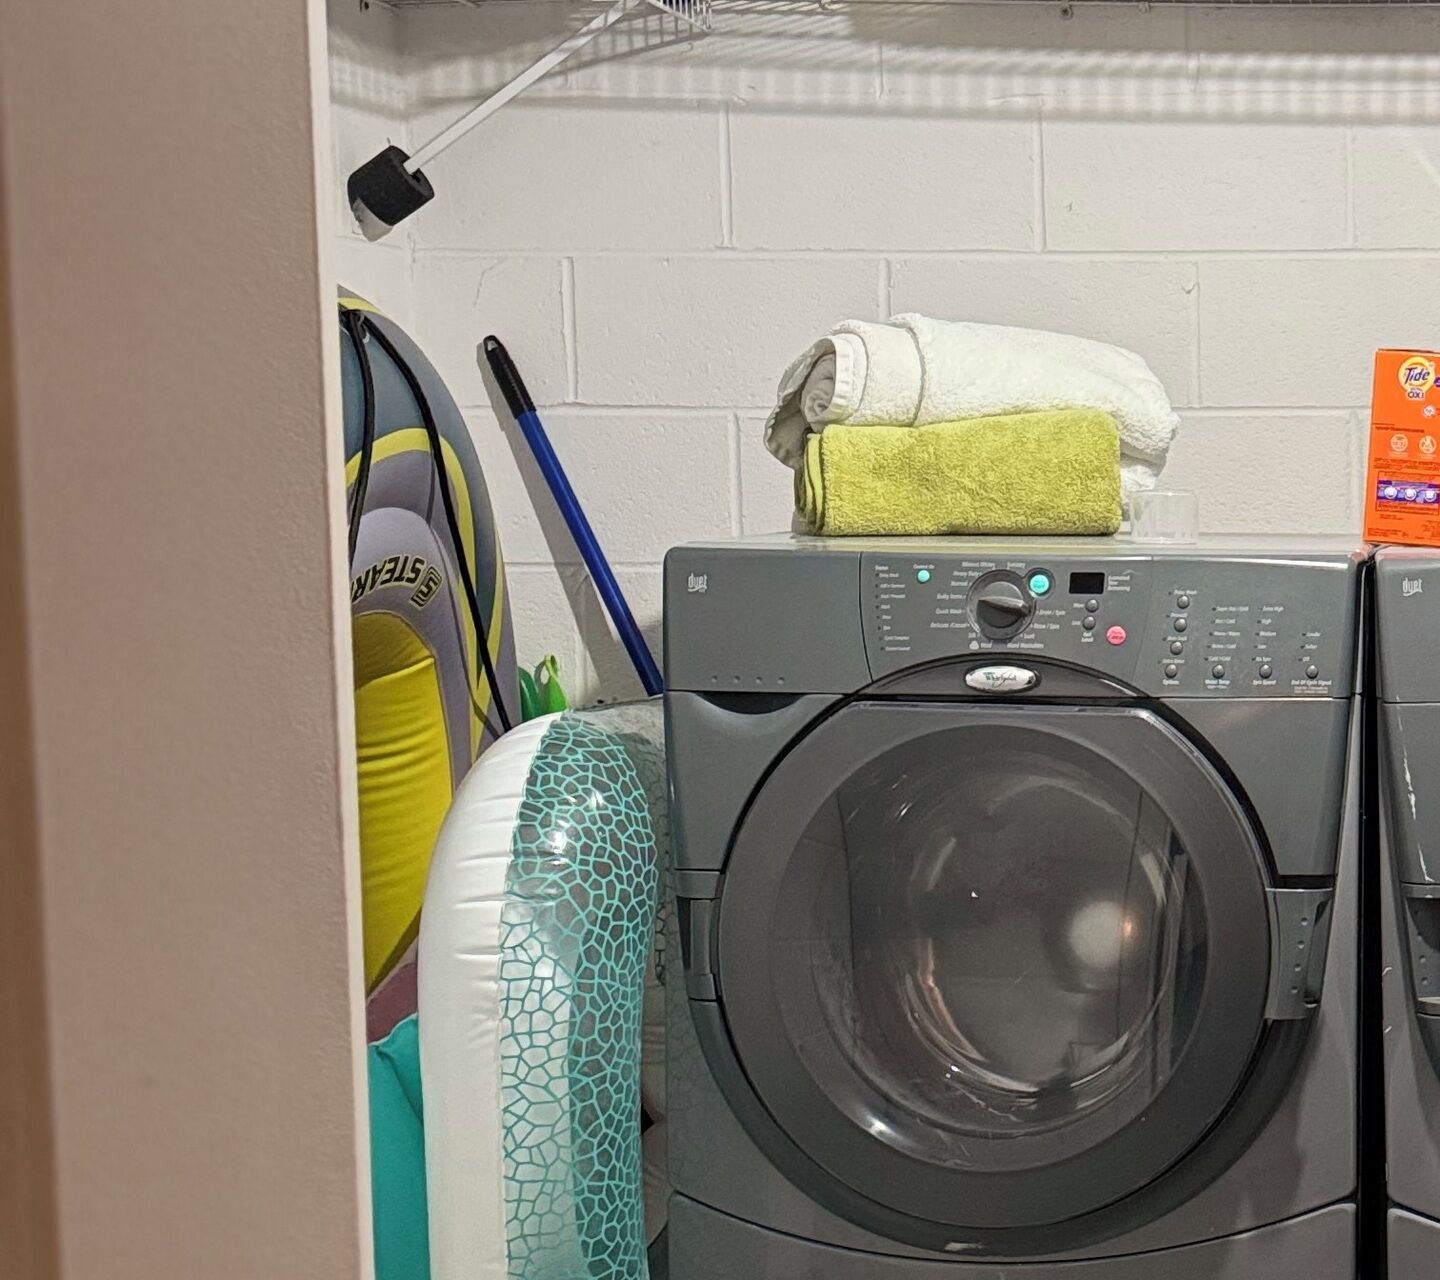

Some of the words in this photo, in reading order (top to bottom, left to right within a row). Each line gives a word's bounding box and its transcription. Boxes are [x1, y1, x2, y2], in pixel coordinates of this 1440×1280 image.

[1404, 366, 1431, 385] Tide
[687, 571, 708, 592] duet
[1402, 576, 1423, 597] duet
